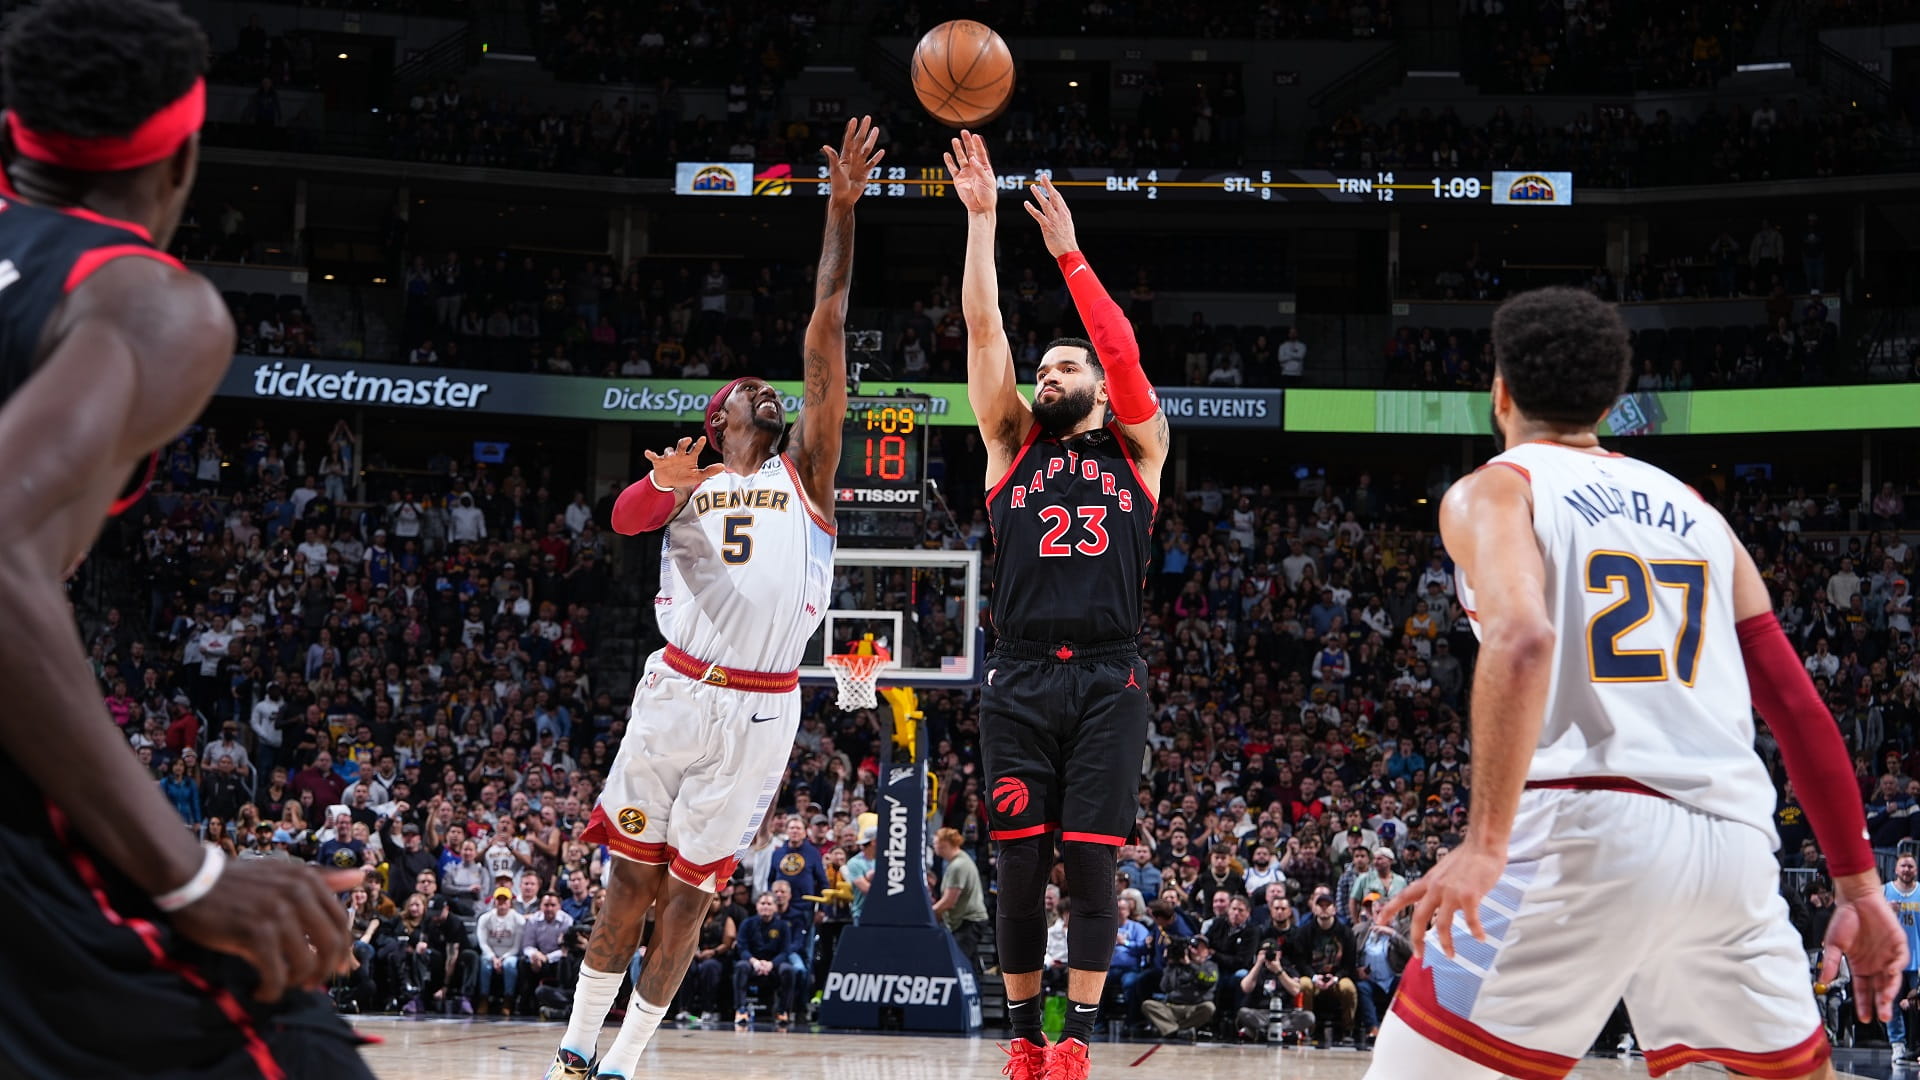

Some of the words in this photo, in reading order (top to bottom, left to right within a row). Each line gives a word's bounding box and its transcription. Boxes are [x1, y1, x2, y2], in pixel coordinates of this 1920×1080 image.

[818, 166, 831, 179] 3
[888, 167, 906, 180] 23
[921, 168, 944, 180] 111
[996, 175, 1027, 190] AST
[1106, 177, 1139, 191] BLK
[1147, 170, 1158, 182] 4
[1224, 177, 1255, 192] STL
[1262, 171, 1272, 183] 5
[1337, 178, 1372, 193] TRN
[1377, 172, 1394, 184] 14
[1431, 176, 1480, 198] 1:09
[864, 184, 882, 196] 25
[888, 184, 906, 196] 29
[921, 185, 945, 197] 112
[1147, 187, 1157, 199] 2
[1261, 187, 1271, 200] 9
[1377, 189, 1394, 201] 12
[254, 362, 487, 408] ticketmaster
[1161, 398, 1194, 416] ING
[1199, 399, 1267, 417] EVENTS
[867, 408, 914, 433] 1:09
[865, 436, 906, 480] 18
[1010, 449, 1132, 512] RAPTORS
[693, 487, 790, 517] DENVER
[855, 489, 919, 503] TISSOT
[1563, 482, 1697, 538] MURRAY
[721, 515, 754, 566] 5
[1038, 505, 1110, 557] 23
[1585, 549, 1709, 688] 27
[884, 806, 908, 896] verizon
[823, 972, 958, 1006] POINTSBET
